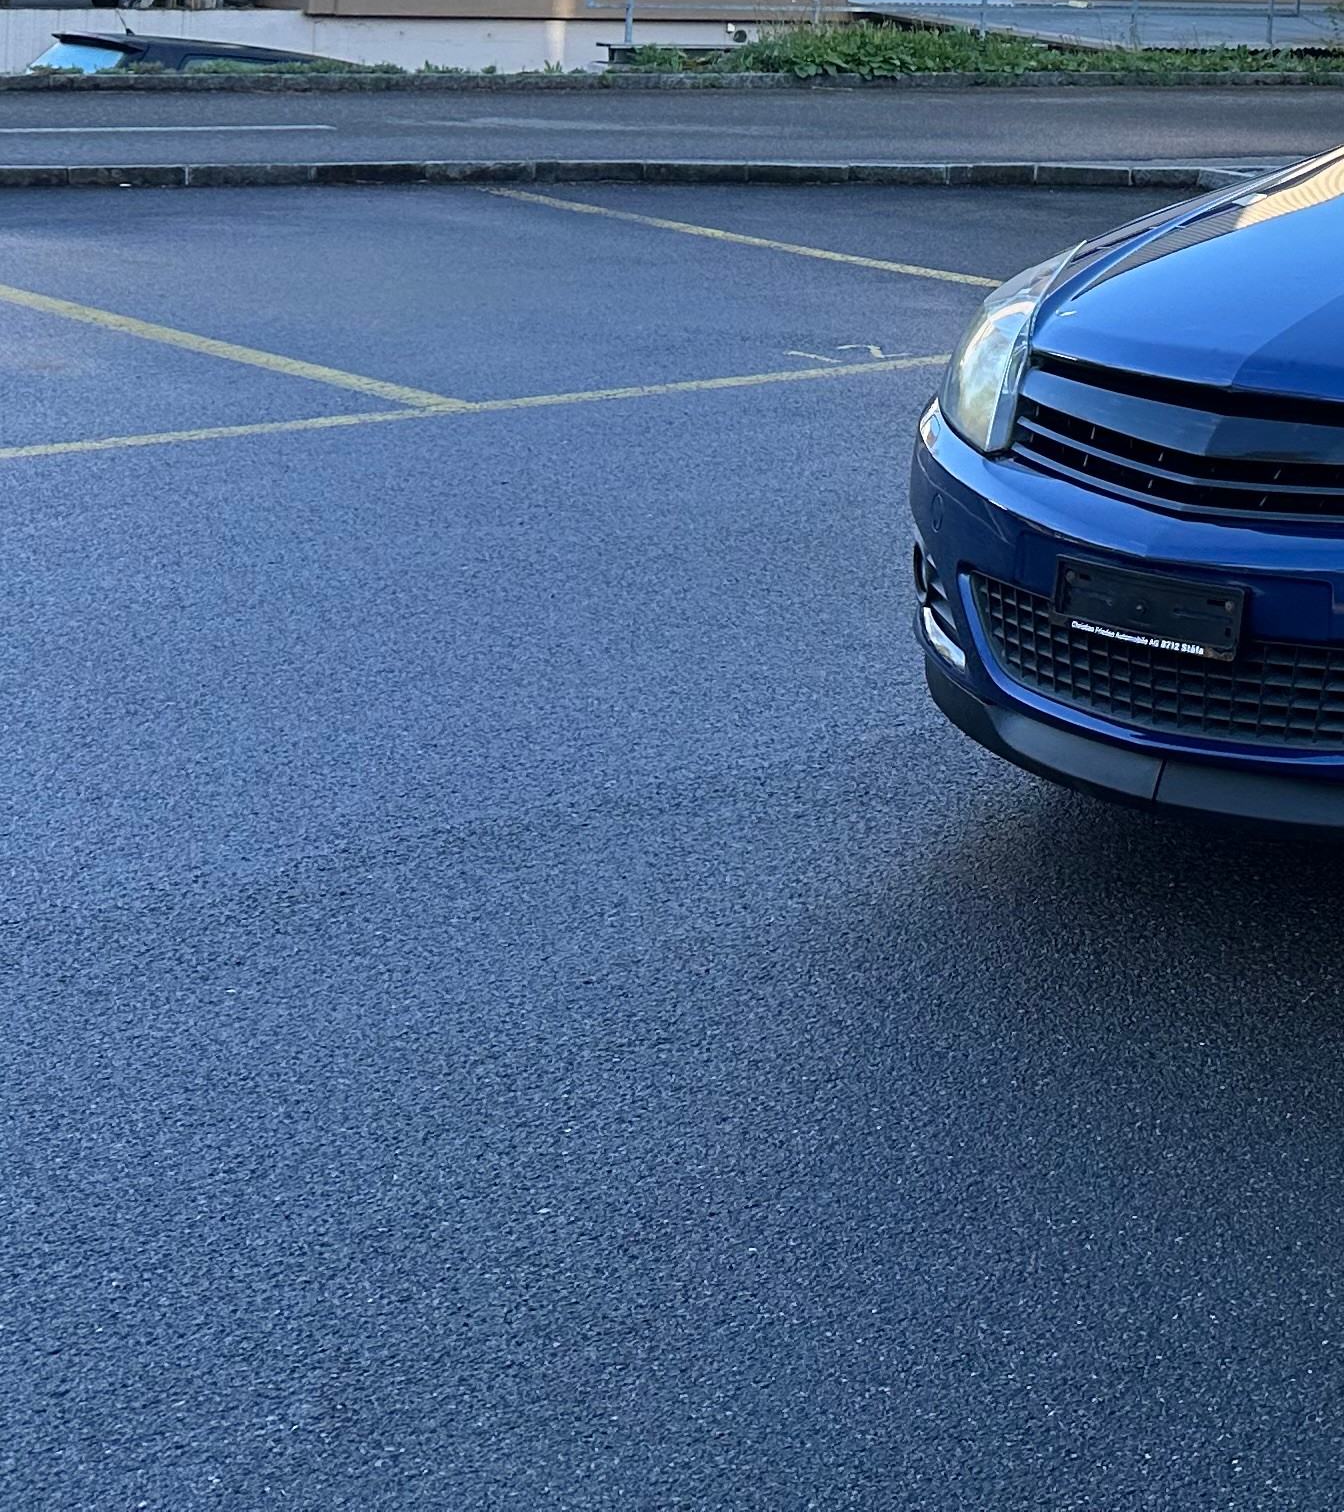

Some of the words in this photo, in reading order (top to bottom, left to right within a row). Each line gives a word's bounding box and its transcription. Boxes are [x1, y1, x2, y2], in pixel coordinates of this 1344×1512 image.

[1149, 638, 1160, 648] AG
[1161, 640, 1180, 651] 8712
[1181, 643, 1204, 655] Stäfa
